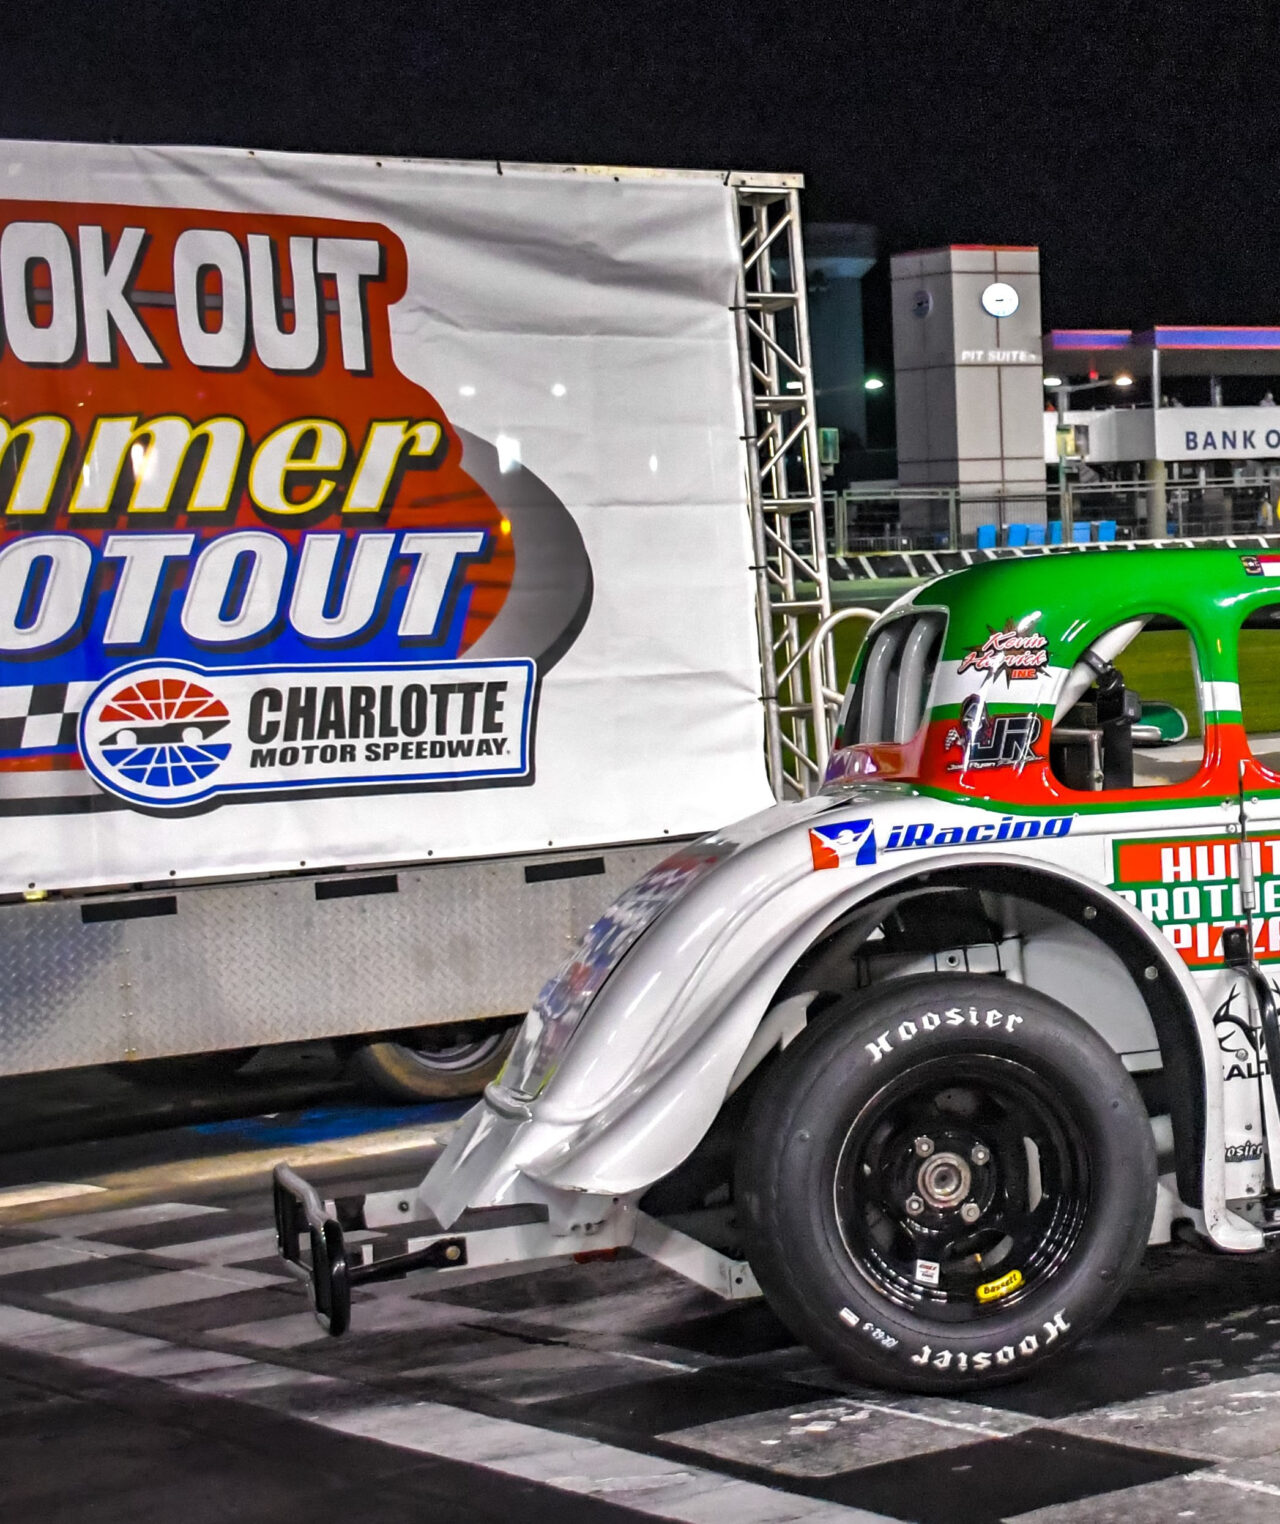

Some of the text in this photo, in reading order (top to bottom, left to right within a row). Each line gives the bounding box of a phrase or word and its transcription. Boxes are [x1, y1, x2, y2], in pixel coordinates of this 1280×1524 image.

[174, 229, 380, 371] OUT
[961, 350, 984, 361] PIT
[1185, 430, 1256, 450] BANK
[958, 650, 1048, 675] Havick
[248, 680, 508, 744] CHARLOTTE
[250, 745, 356, 768] MOTOR
[886, 816, 1074, 850] iRacing
[865, 1007, 1024, 1065] Hoosier
[984, 1274, 1018, 1295] Bassett
[910, 1308, 1071, 1371] Hoosier
